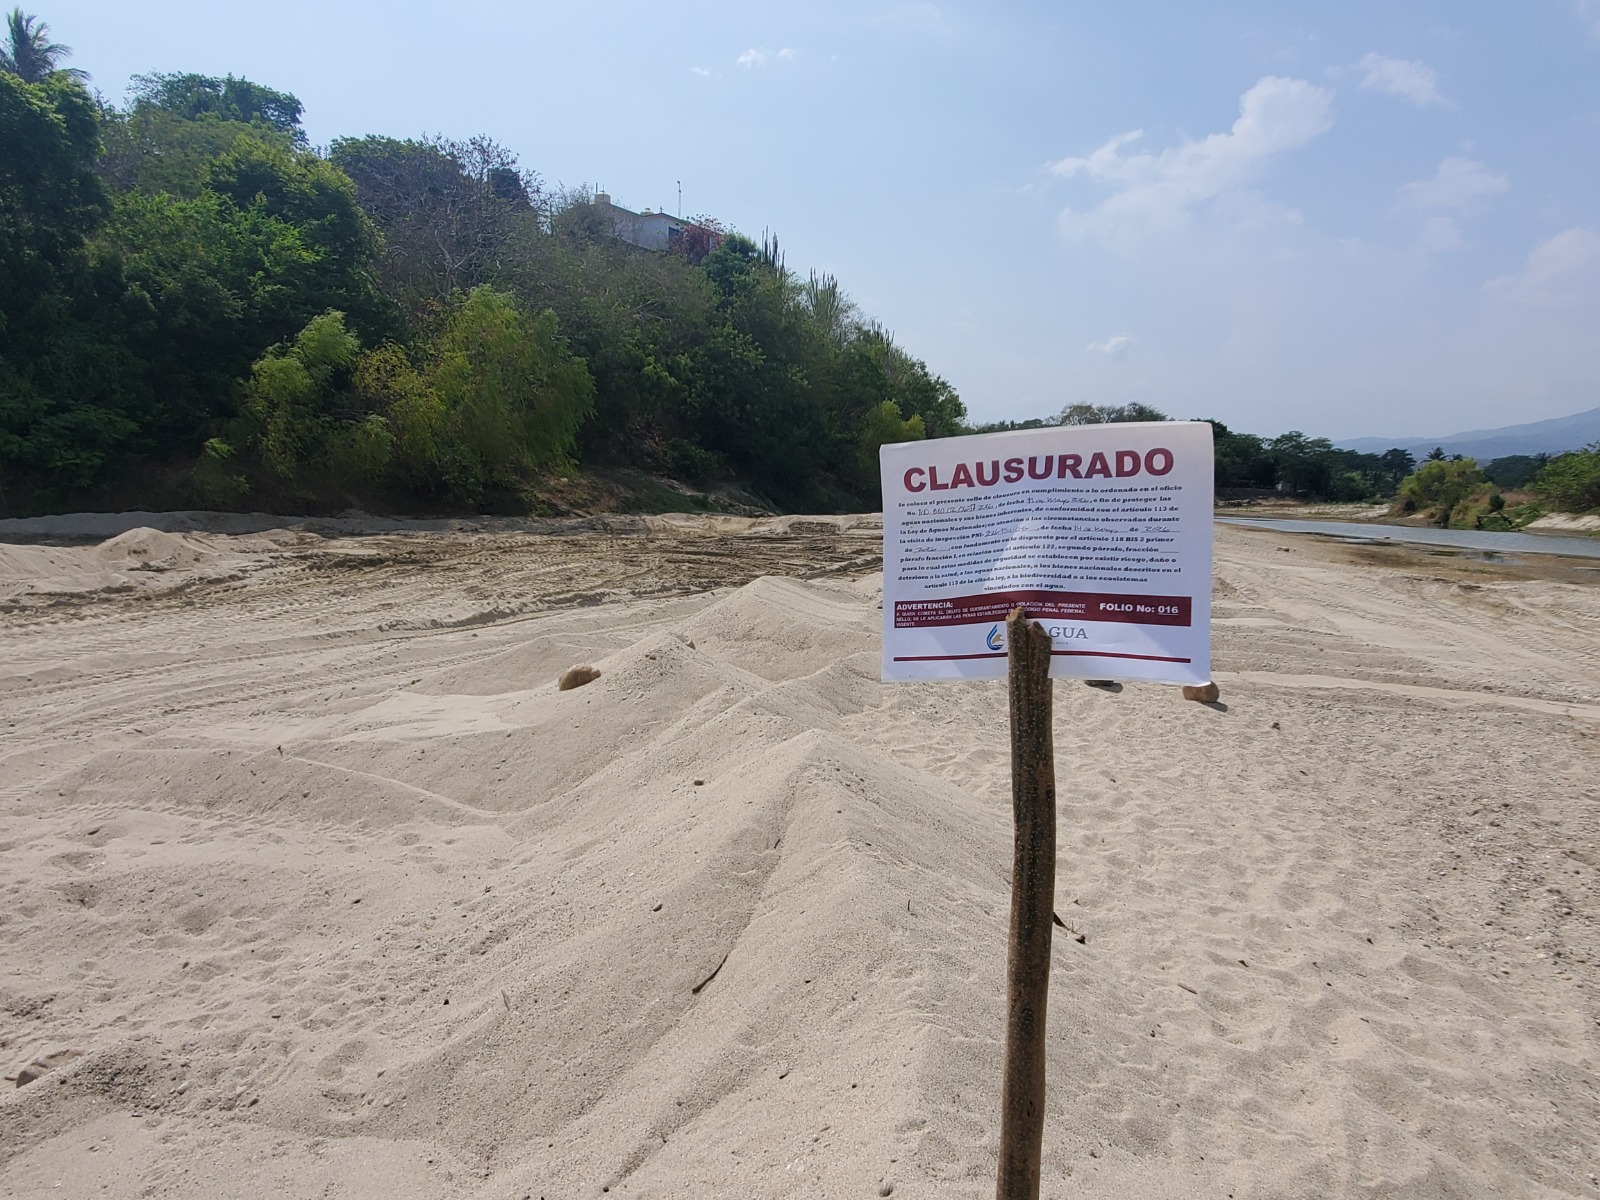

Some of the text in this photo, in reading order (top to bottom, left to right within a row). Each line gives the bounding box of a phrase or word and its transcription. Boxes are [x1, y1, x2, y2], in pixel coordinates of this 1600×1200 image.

[904, 448, 1174, 492] CLAUSURADO
[993, 491, 1020, 499] clausura
[997, 507, 1034, 516] inherentes,
[996, 517, 1024, 526] atención
[964, 539, 1001, 549] fundamento
[993, 554, 1026, 562] seguridad
[896, 602, 953, 610] ADVERTENCIA:
[1100, 603, 1179, 614] FOLIO No: 016
